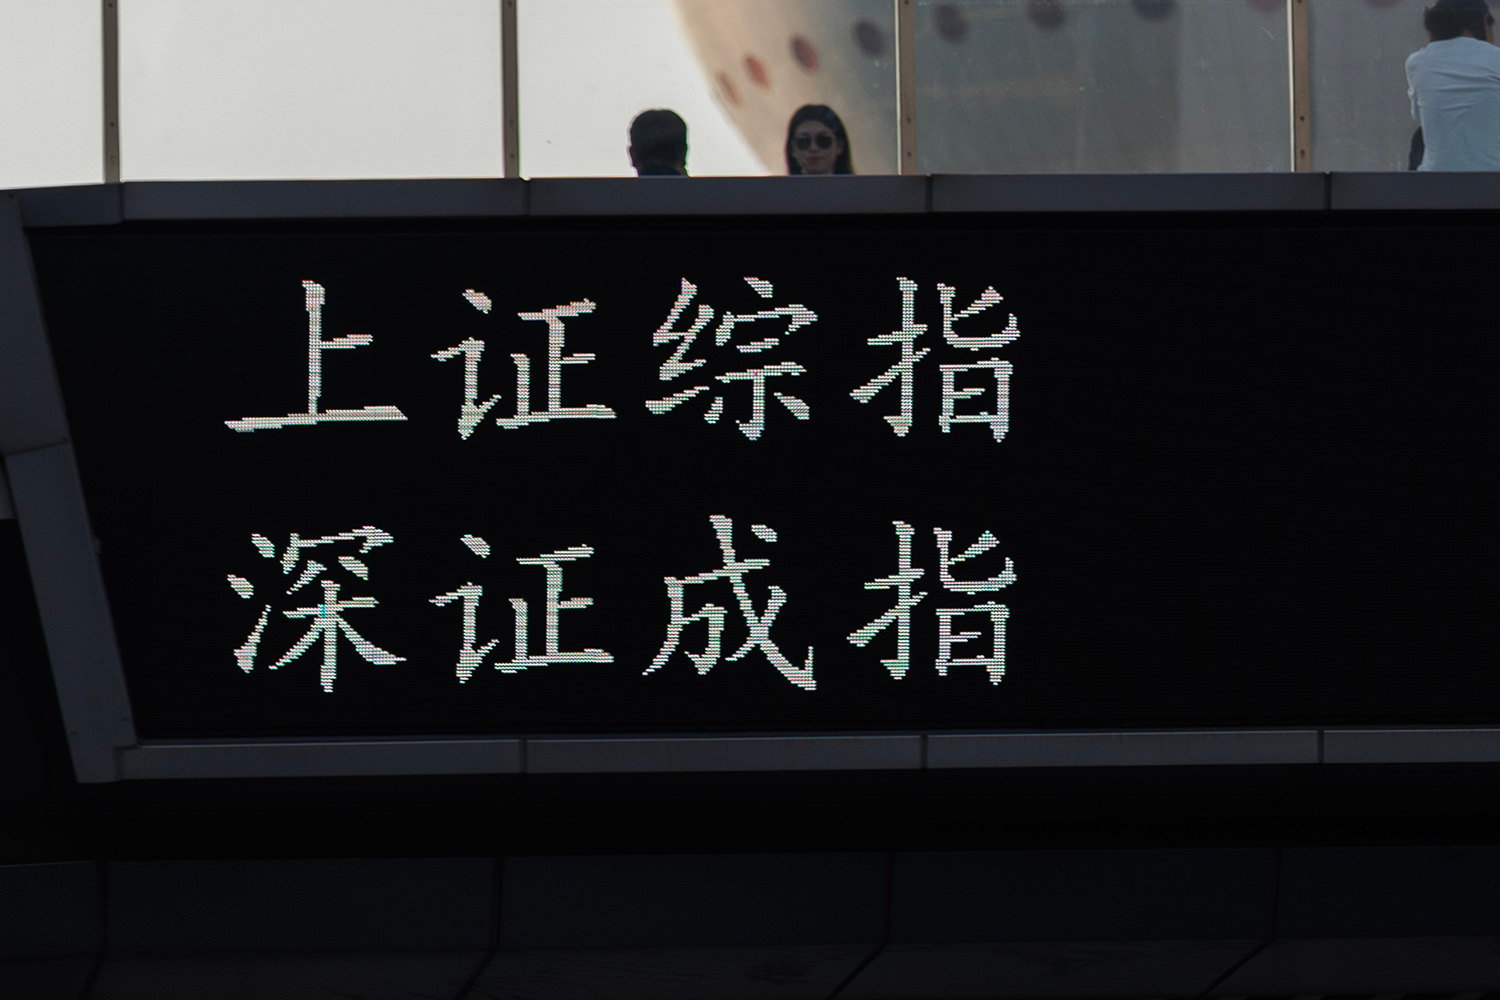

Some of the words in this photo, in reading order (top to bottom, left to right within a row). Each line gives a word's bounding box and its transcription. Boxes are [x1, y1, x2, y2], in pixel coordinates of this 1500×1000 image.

[225, 277, 1021, 443] 上证综指
[227, 514, 1017, 693] 深证成指
